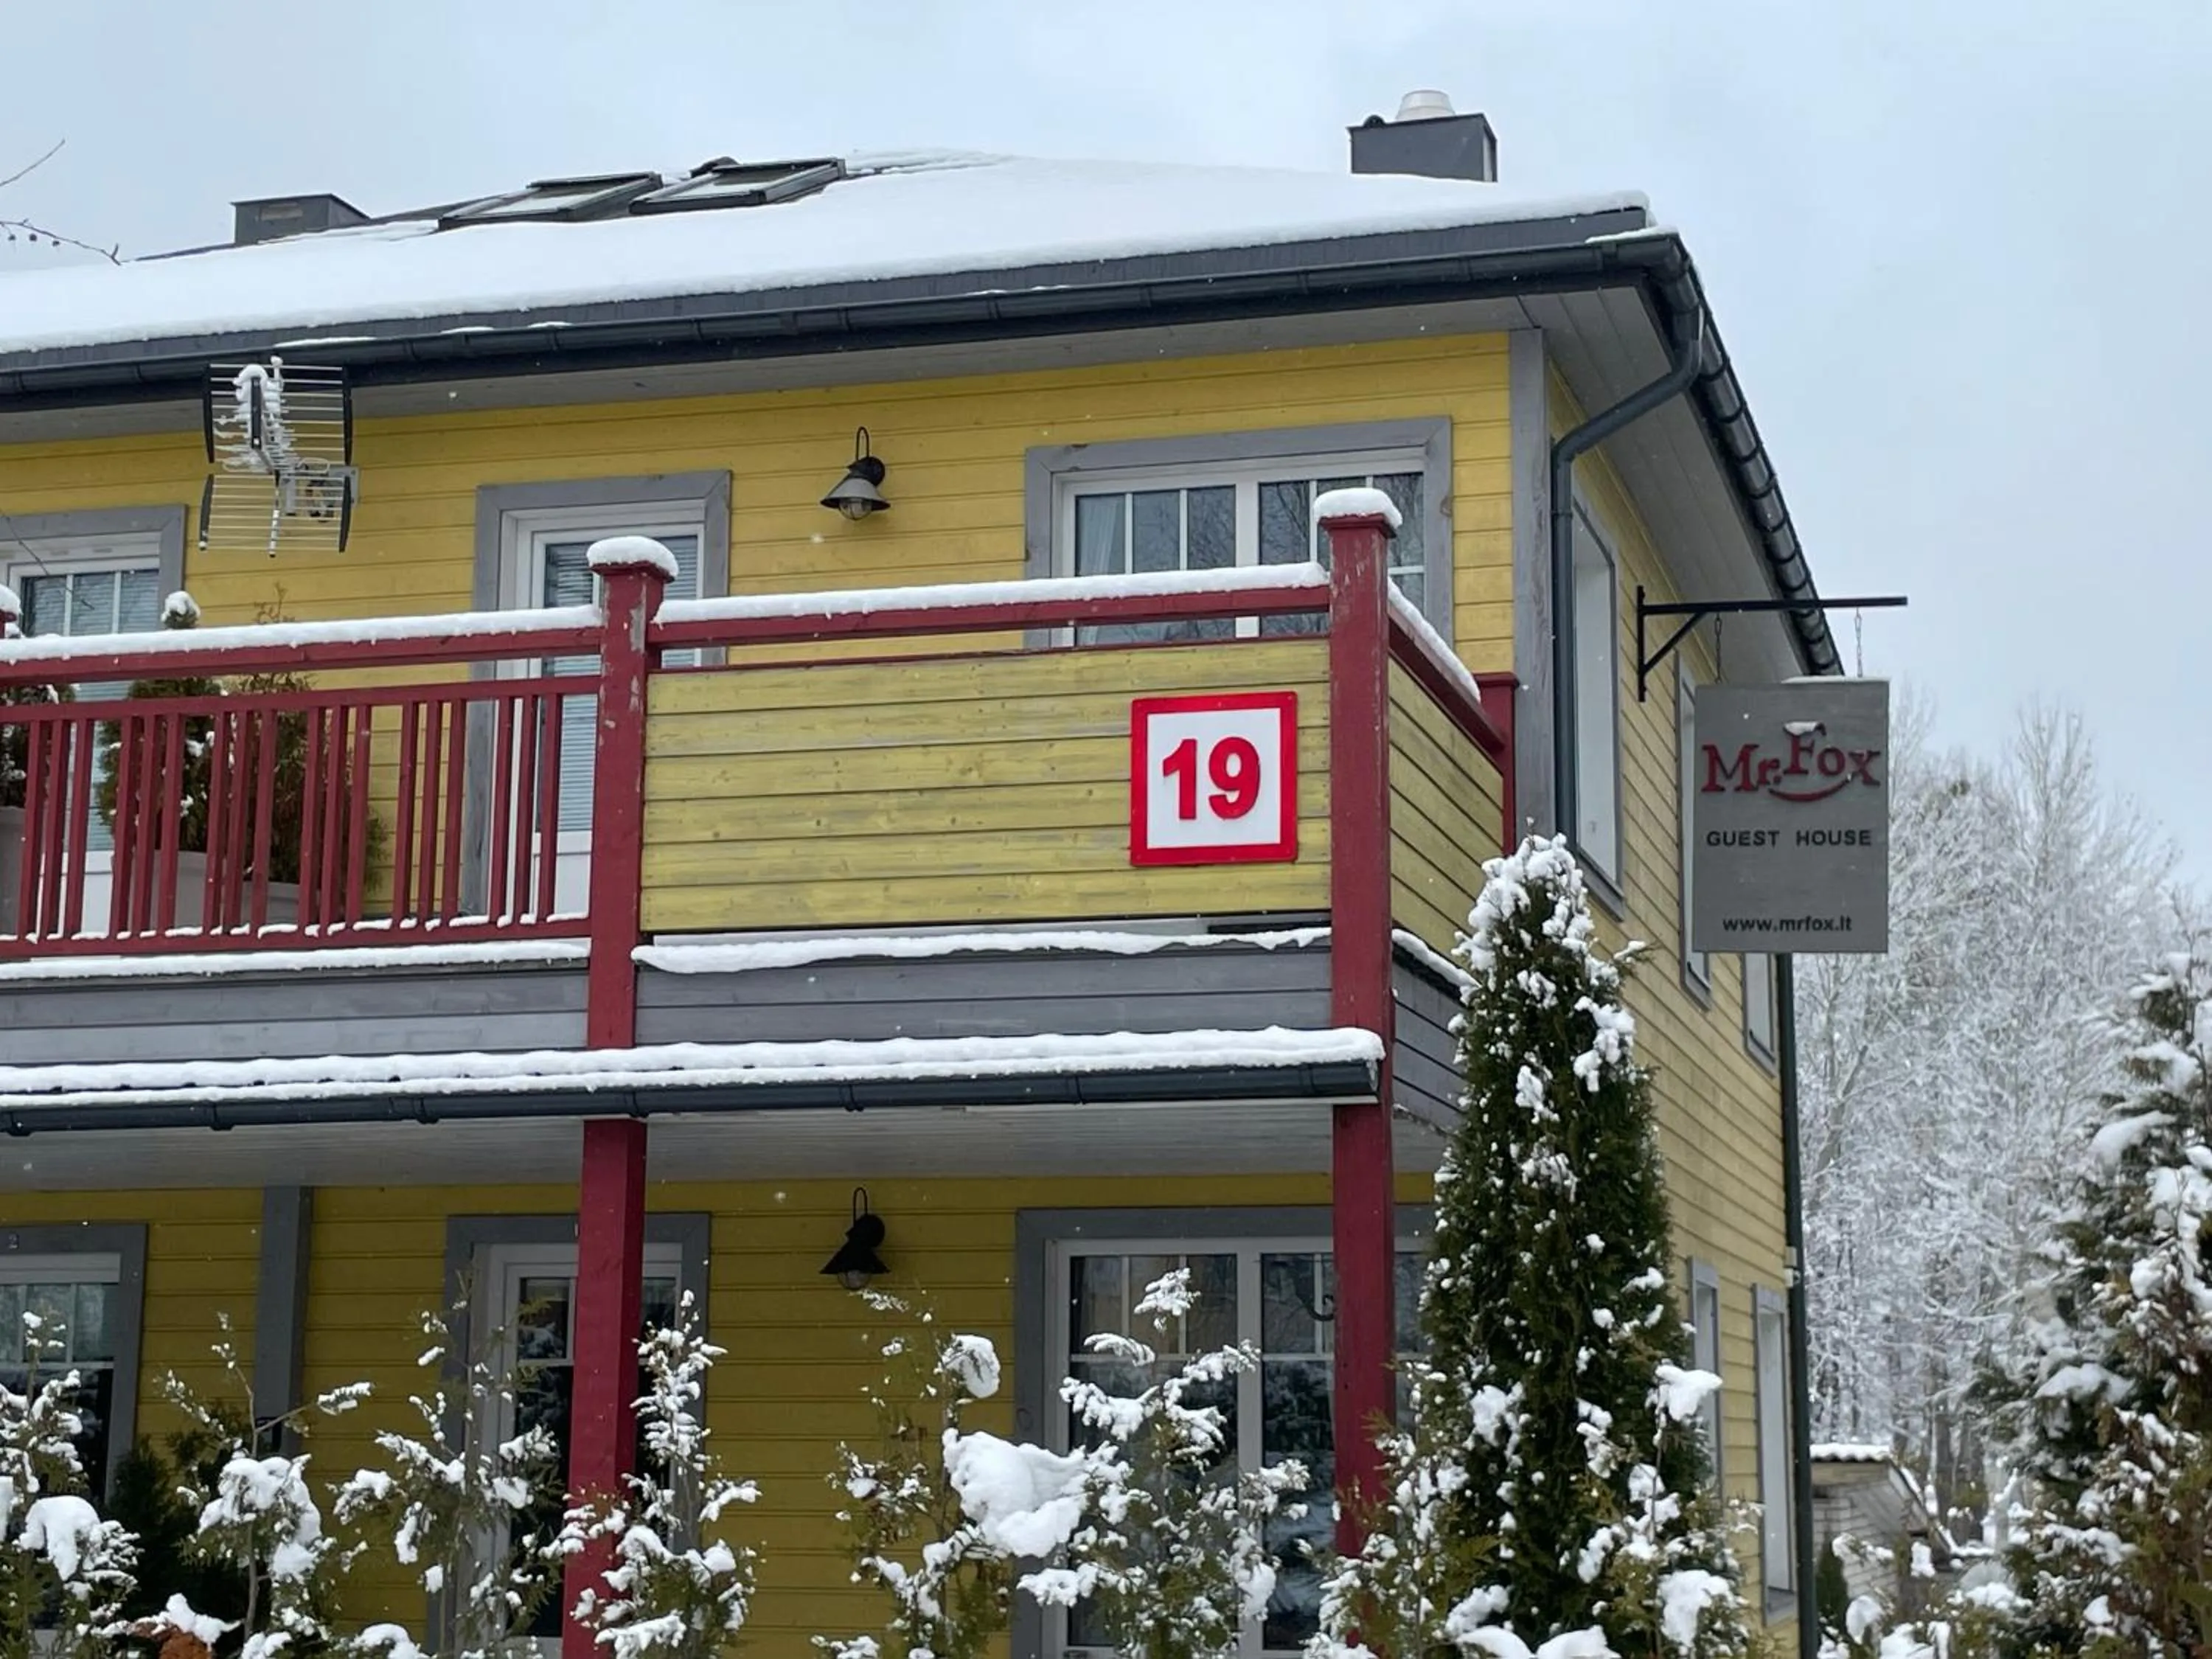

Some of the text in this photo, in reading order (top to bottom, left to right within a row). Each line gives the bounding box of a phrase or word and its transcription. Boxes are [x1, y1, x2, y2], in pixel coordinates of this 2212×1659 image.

[1163, 736, 1261, 821] 19
[1701, 721, 1881, 793] Mr. Fox
[1706, 830, 1871, 846] GUEST HOUSE
[1722, 916, 1852, 931] www.mrfox.lt
